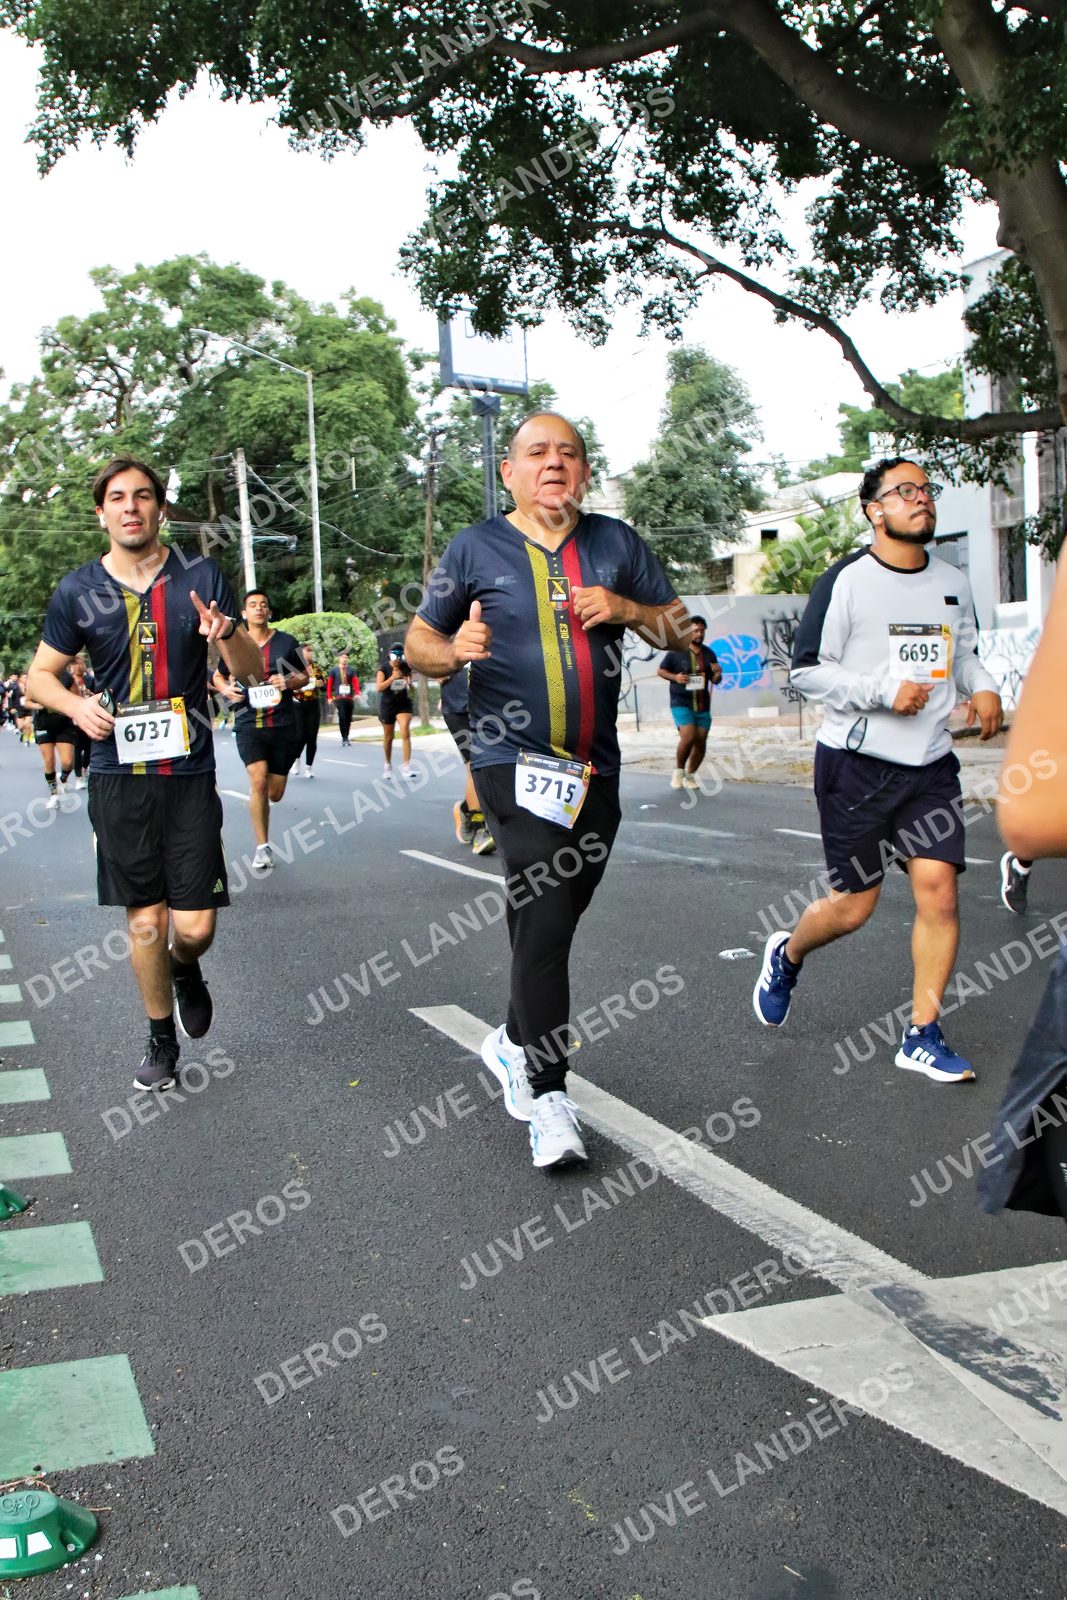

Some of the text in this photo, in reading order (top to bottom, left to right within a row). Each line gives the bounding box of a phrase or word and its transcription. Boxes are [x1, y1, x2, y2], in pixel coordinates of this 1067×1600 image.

[899, 643, 939, 662] 6695
[124, 718, 171, 742] 6737
[525, 773, 576, 803] 3715
